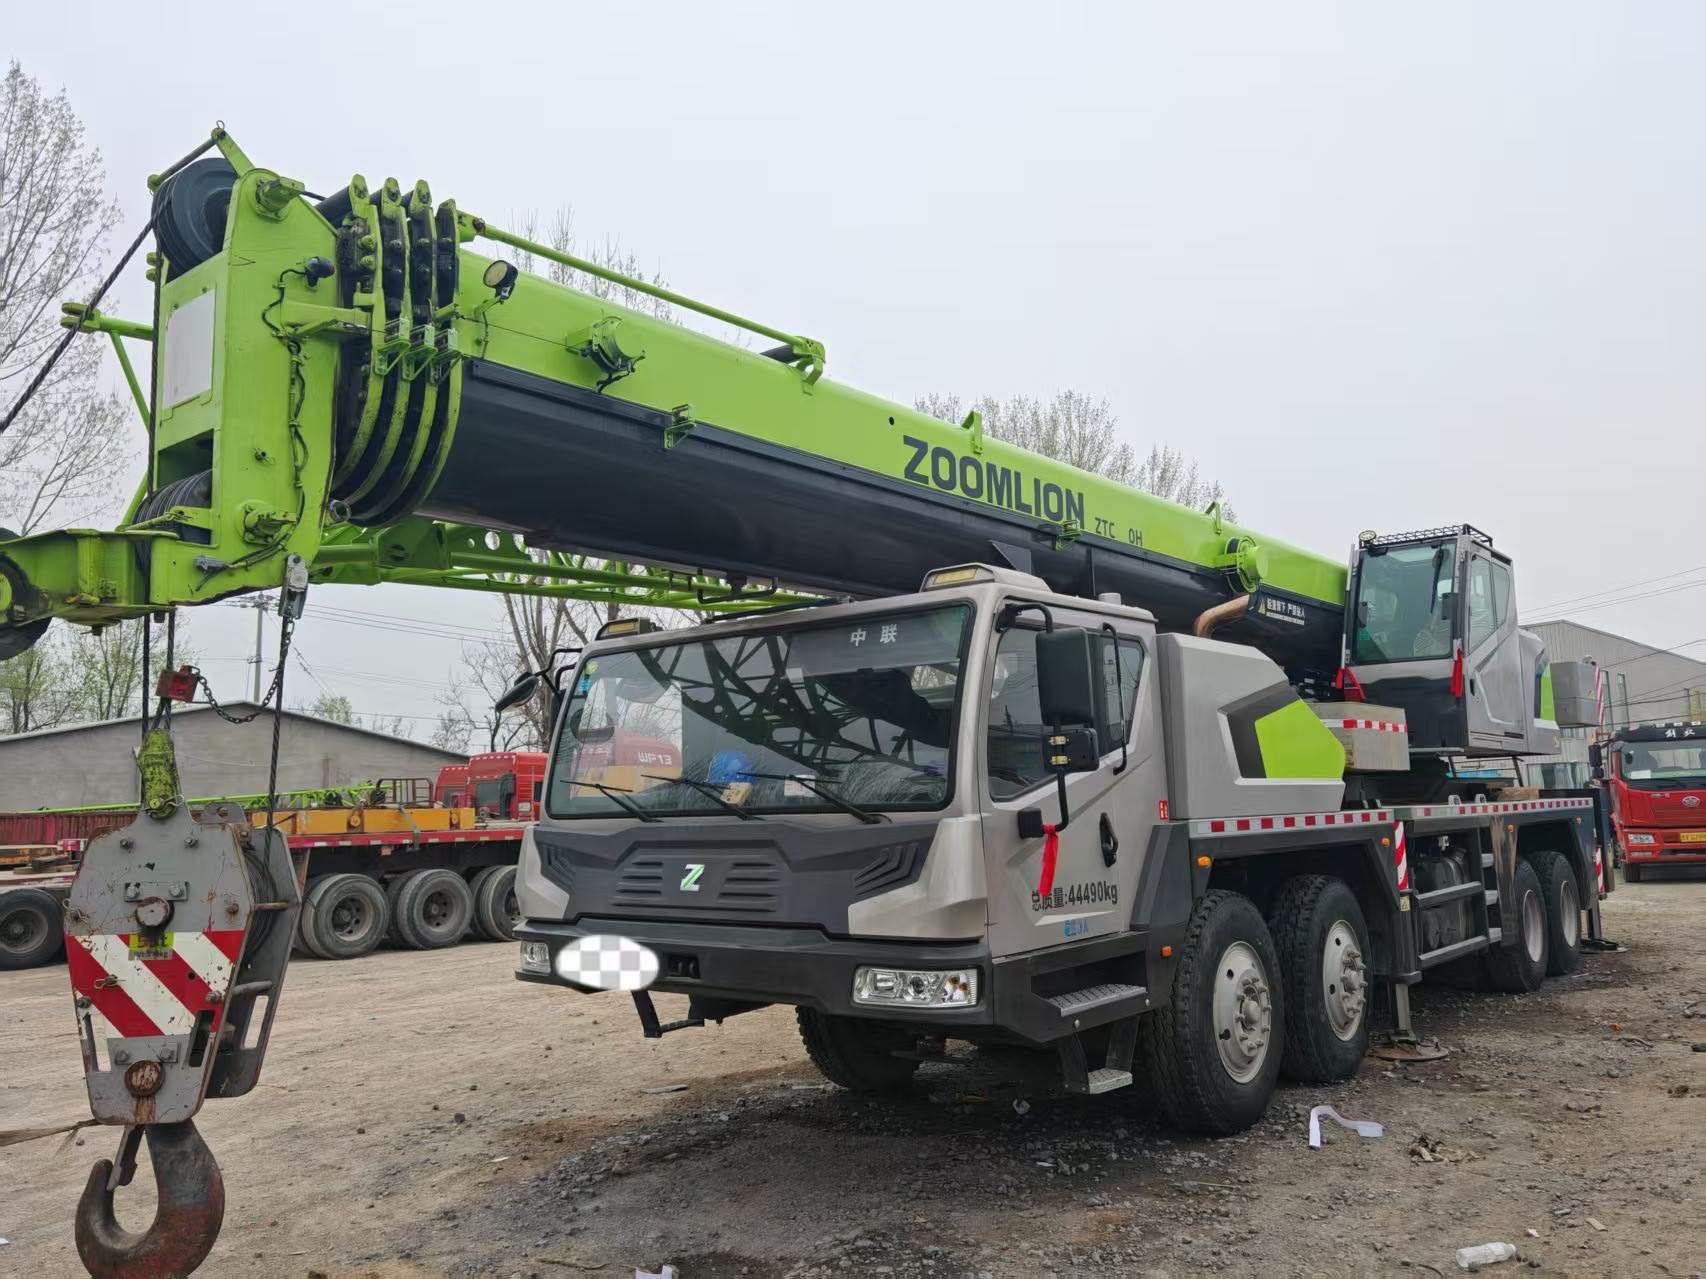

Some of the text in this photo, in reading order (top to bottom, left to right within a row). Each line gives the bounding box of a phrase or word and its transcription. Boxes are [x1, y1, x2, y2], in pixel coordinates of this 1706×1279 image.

[903, 434, 1085, 530] ZOOMLION
[1094, 517, 1116, 539] ZTC
[850, 624, 897, 647] 中联
[1031, 880, 1118, 912] 总质量:44490kg
